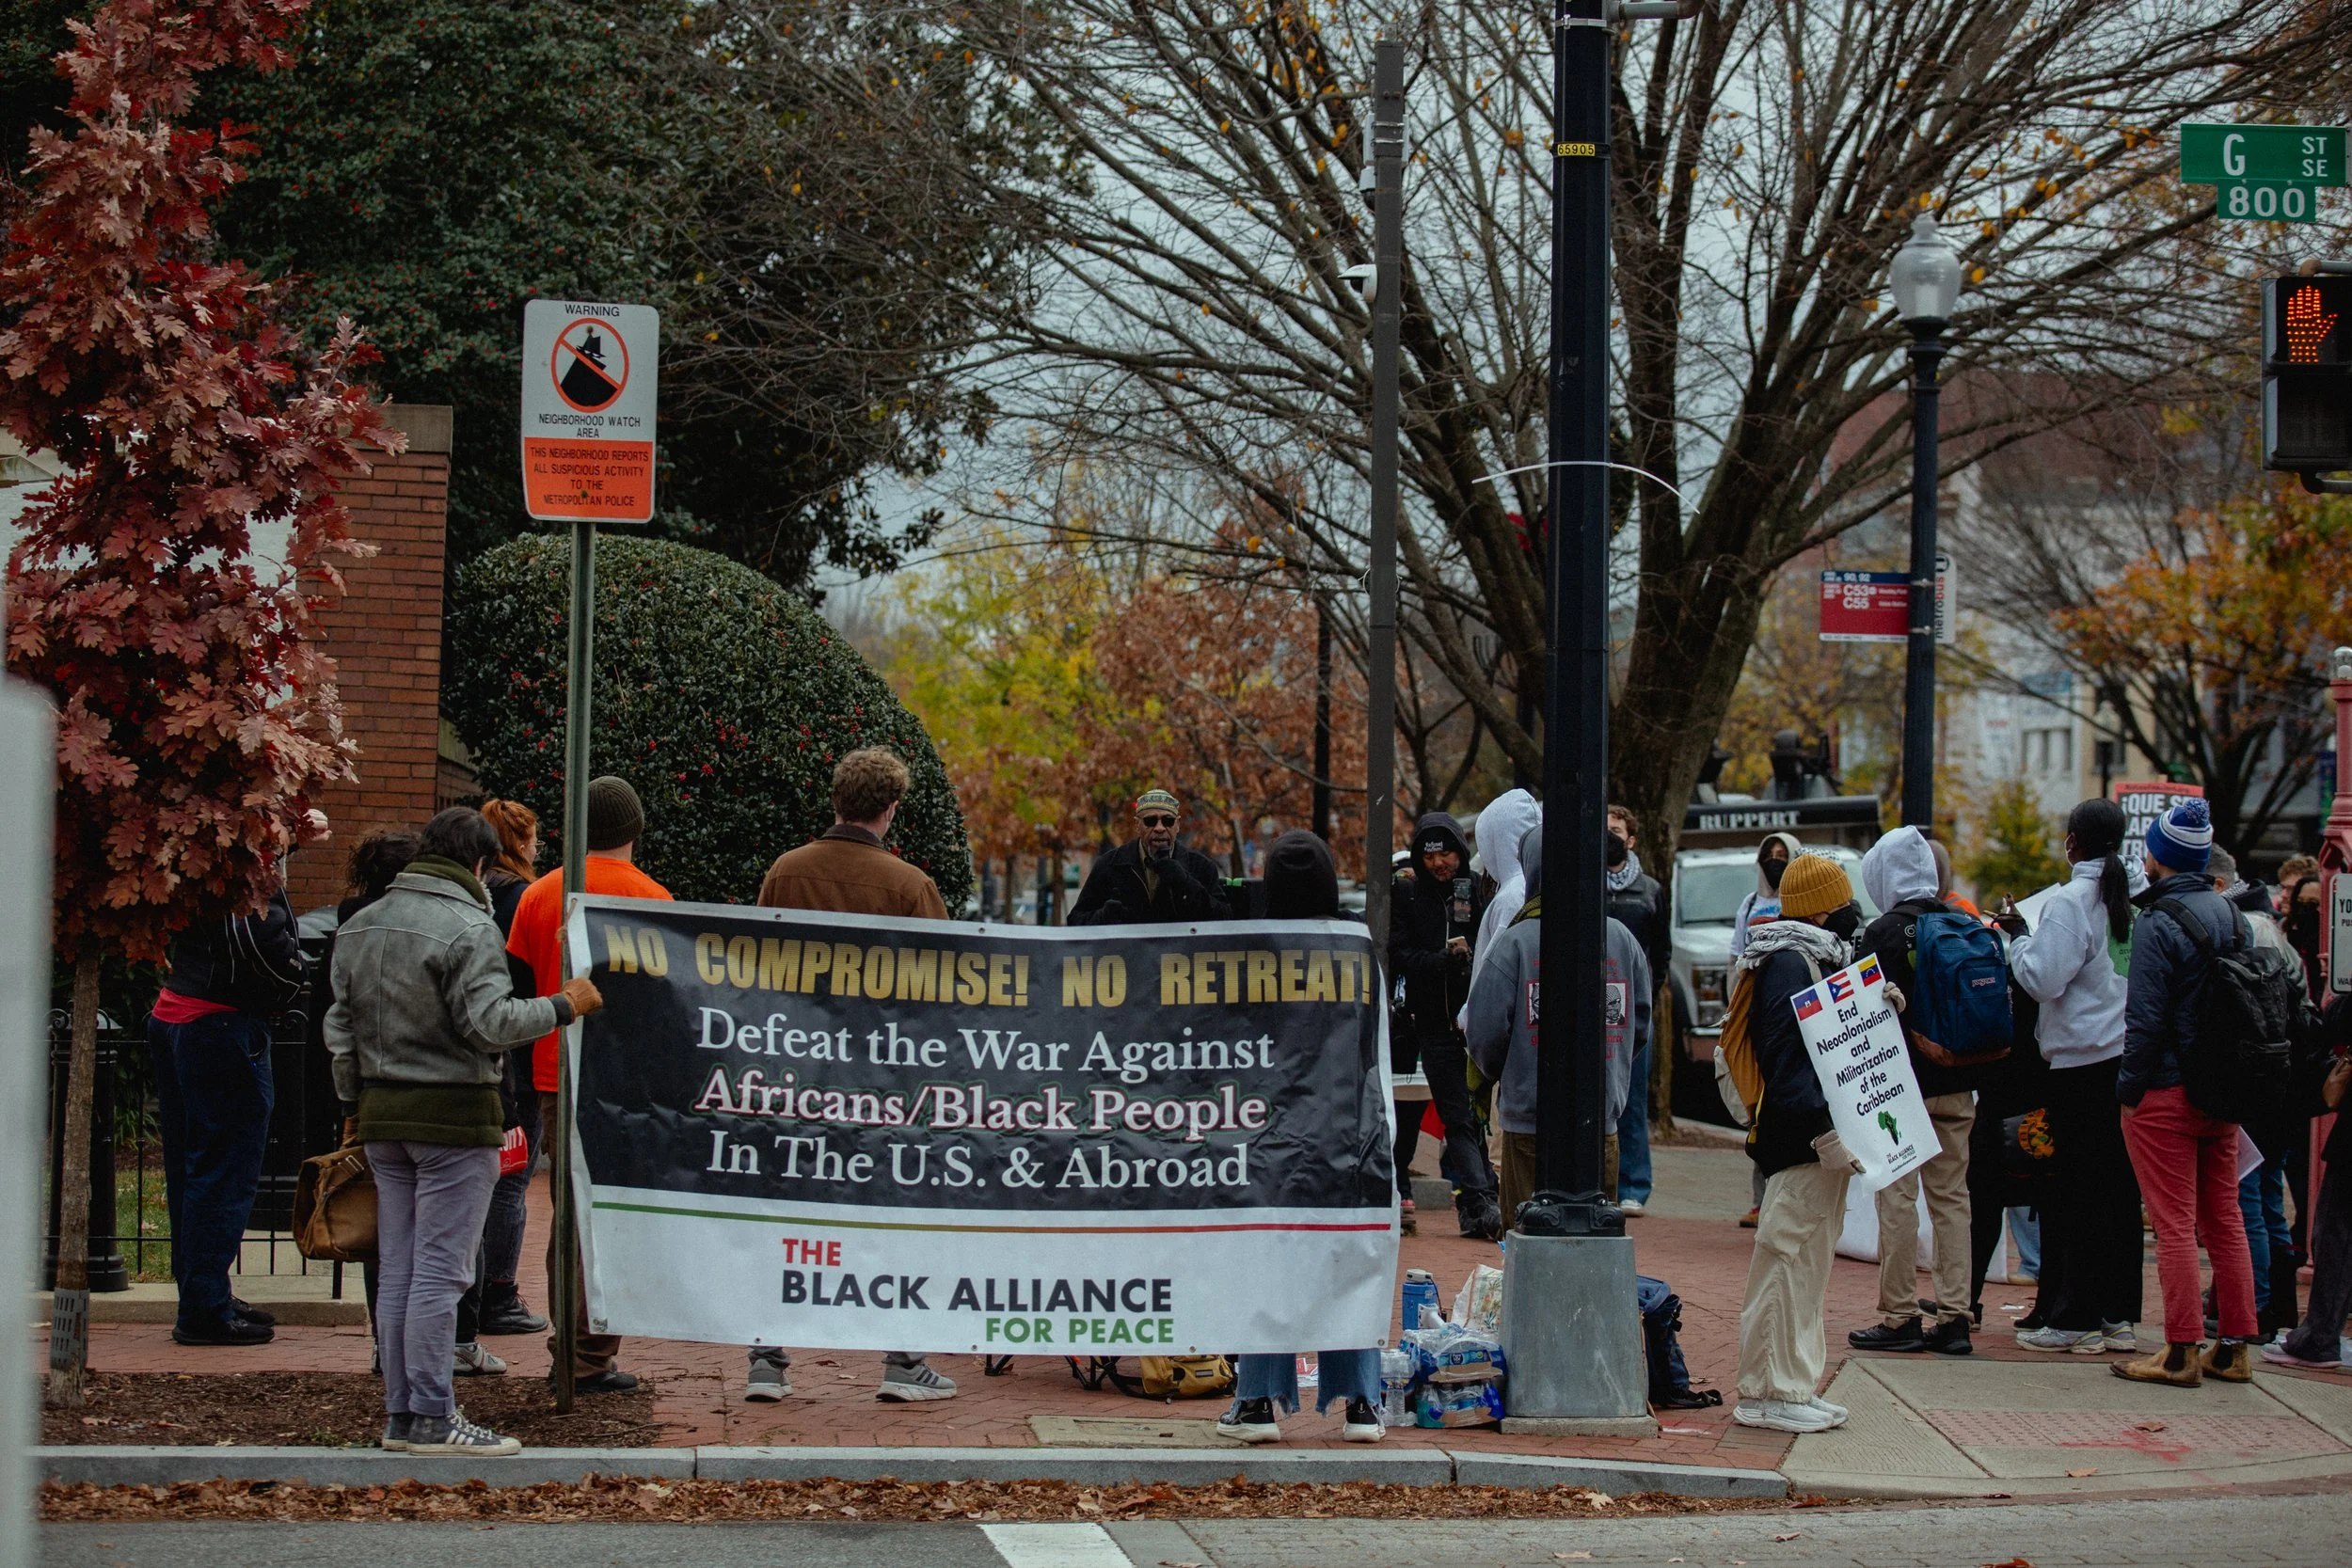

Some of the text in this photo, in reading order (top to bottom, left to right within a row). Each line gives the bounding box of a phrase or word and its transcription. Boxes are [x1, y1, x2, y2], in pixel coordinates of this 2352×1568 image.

[1558, 144, 1595, 155] 65905
[2223, 134, 2328, 176] G ST
[2302, 159, 2328, 177] SE
[2228, 186, 2305, 217] 800
[564, 304, 620, 317] WARNING
[538, 414, 641, 427] NEIGHBORHOOD WATCH
[577, 428, 599, 438] AREA
[531, 447, 649, 462] THIS NEIGHBORHOOD REPORTS
[533, 463, 644, 477] ALL SUSPICIOUS ACTIVITY
[570, 480, 603, 490] TO THE
[544, 495, 634, 506] METROPOLITAN POLICE
[1699, 810, 1800, 830] RUPPERT
[604, 924, 1371, 1007] NO COMPROMISE! NO RETREAT!
[1837, 1000, 1859, 1023] End
[1816, 1008, 1892, 1055] Neocolonialism
[697, 1006, 1275, 1084] Defeat the War Against
[1851, 1035, 1871, 1057] and
[1836, 1046, 1899, 1087] Militarization
[1860, 1071, 1887, 1094] of the
[694, 1068, 1267, 1142] Africans/Black People
[1856, 1083, 1905, 1117] Caribbean
[706, 1130, 1251, 1189] In The U.S. & Abroad
[782, 1238, 841, 1267] THE
[782, 1270, 1172, 1313] BLACK ALLIANCE
[985, 1318, 1174, 1343] FOR PEACE
